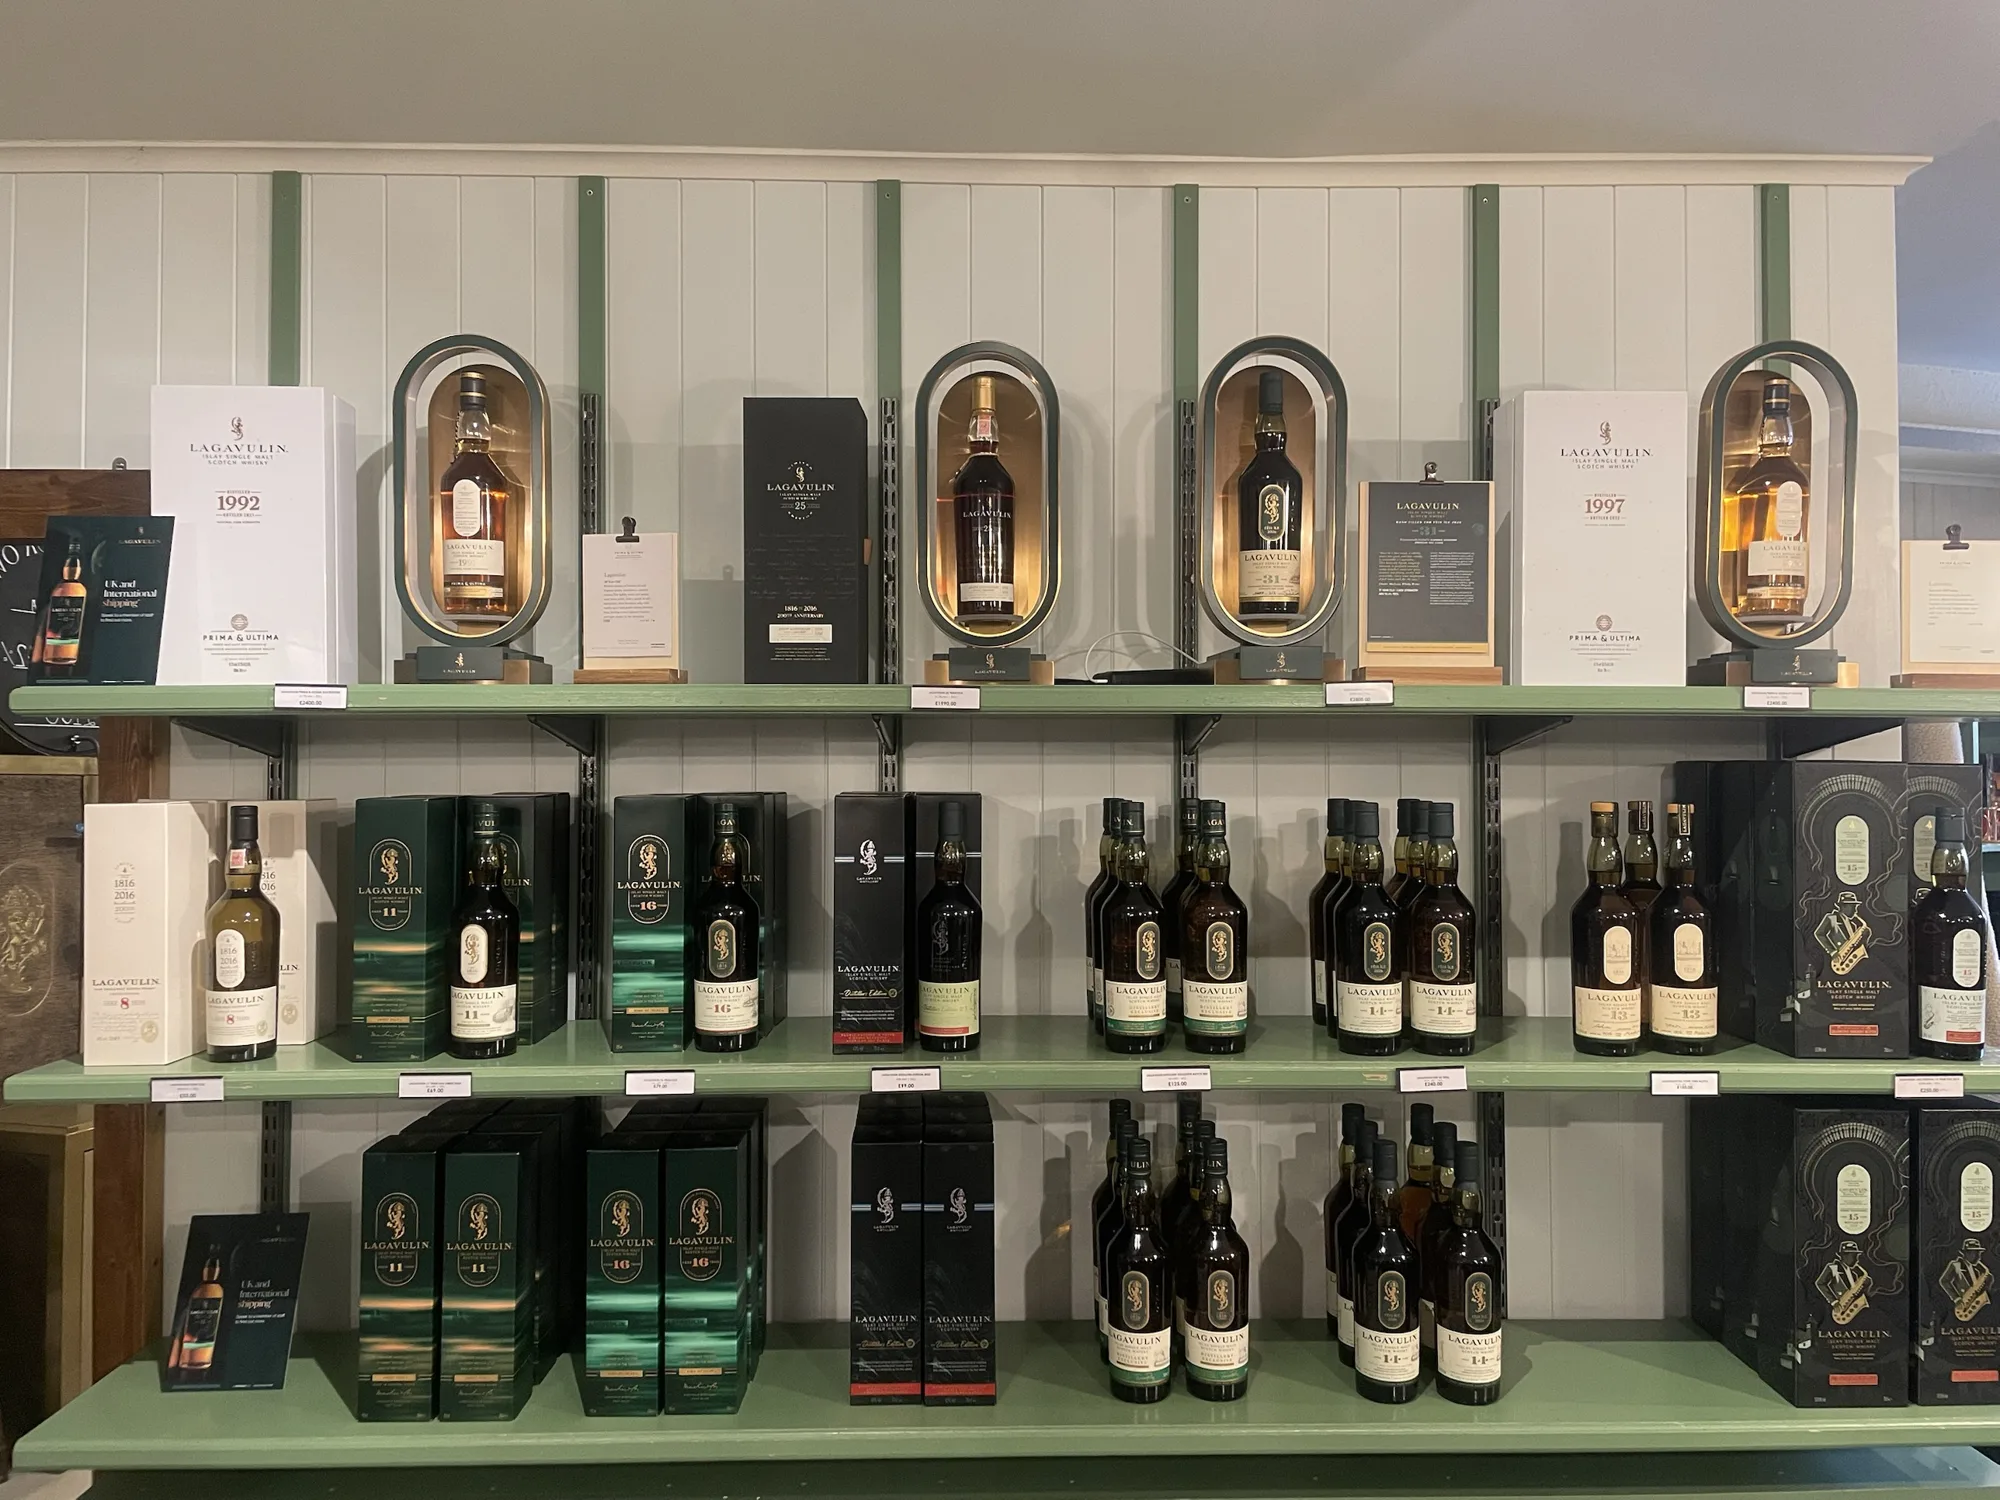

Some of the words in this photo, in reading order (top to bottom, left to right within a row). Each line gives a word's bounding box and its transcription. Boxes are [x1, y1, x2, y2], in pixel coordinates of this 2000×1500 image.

[766, 483, 835, 491] LAGAVULIN
[217, 495, 260, 511] 1992
[794, 501, 806, 510] 25
[1396, 502, 1460, 510] LAGAVULIN
[1585, 498, 1625, 514] 1997
[962, 511, 1012, 519] LAGAVULIN
[105, 580, 119, 588] UK
[119, 580, 136, 588] and
[1262, 575, 1280, 584] 31
[103, 589, 157, 598] International
[236, 634, 244, 642] &
[1600, 634, 1608, 642] &
[1847, 864, 1858, 872] 15
[261, 871, 276, 880] 816
[701, 875, 760, 883] LALIN
[114, 879, 136, 888] 1816
[261, 883, 276, 891] 016
[114, 891, 136, 900] 2016
[358, 887, 423, 895] LAGAVULIN
[640, 901, 657, 911] 16
[383, 907, 397, 917] 11
[220, 947, 237, 955] 1816
[837, 965, 900, 973] LAGAVULIN
[1963, 969, 1972, 977] 15
[697, 985, 751, 994] LAGAVULIN
[1189, 985, 1244, 995] LAGAVULIN
[1416, 986, 1473, 996] LAGAVULIN
[120, 997, 130, 1010] 8
[207, 995, 265, 1005] LAGAVULIN
[714, 1004, 731, 1013] 16
[226, 1014, 235, 1025] 8
[464, 1010, 479, 1020] 11
[1848, 1213, 1859, 1221] 15
[363, 1241, 429, 1250] LAGAVULIN
[447, 1242, 512, 1251] LAGAVULIN
[590, 1238, 654, 1248] LAGAVULIN
[612, 1259, 630, 1270] 16
[692, 1257, 709, 1268] 16
[389, 1263, 403, 1272] 11
[471, 1263, 486, 1273] 11
[255, 1280, 271, 1288] and
[239, 1289, 290, 1298] International
[855, 1315, 917, 1323] LAGAVULIN
[929, 1316, 990, 1324] LAGAVULIN
[1941, 1327, 2000, 1335] LAGAVULI
[1190, 1330, 1245, 1344] LAGAVULIN
[1362, 1331, 1418, 1345] LAGAVULIN
